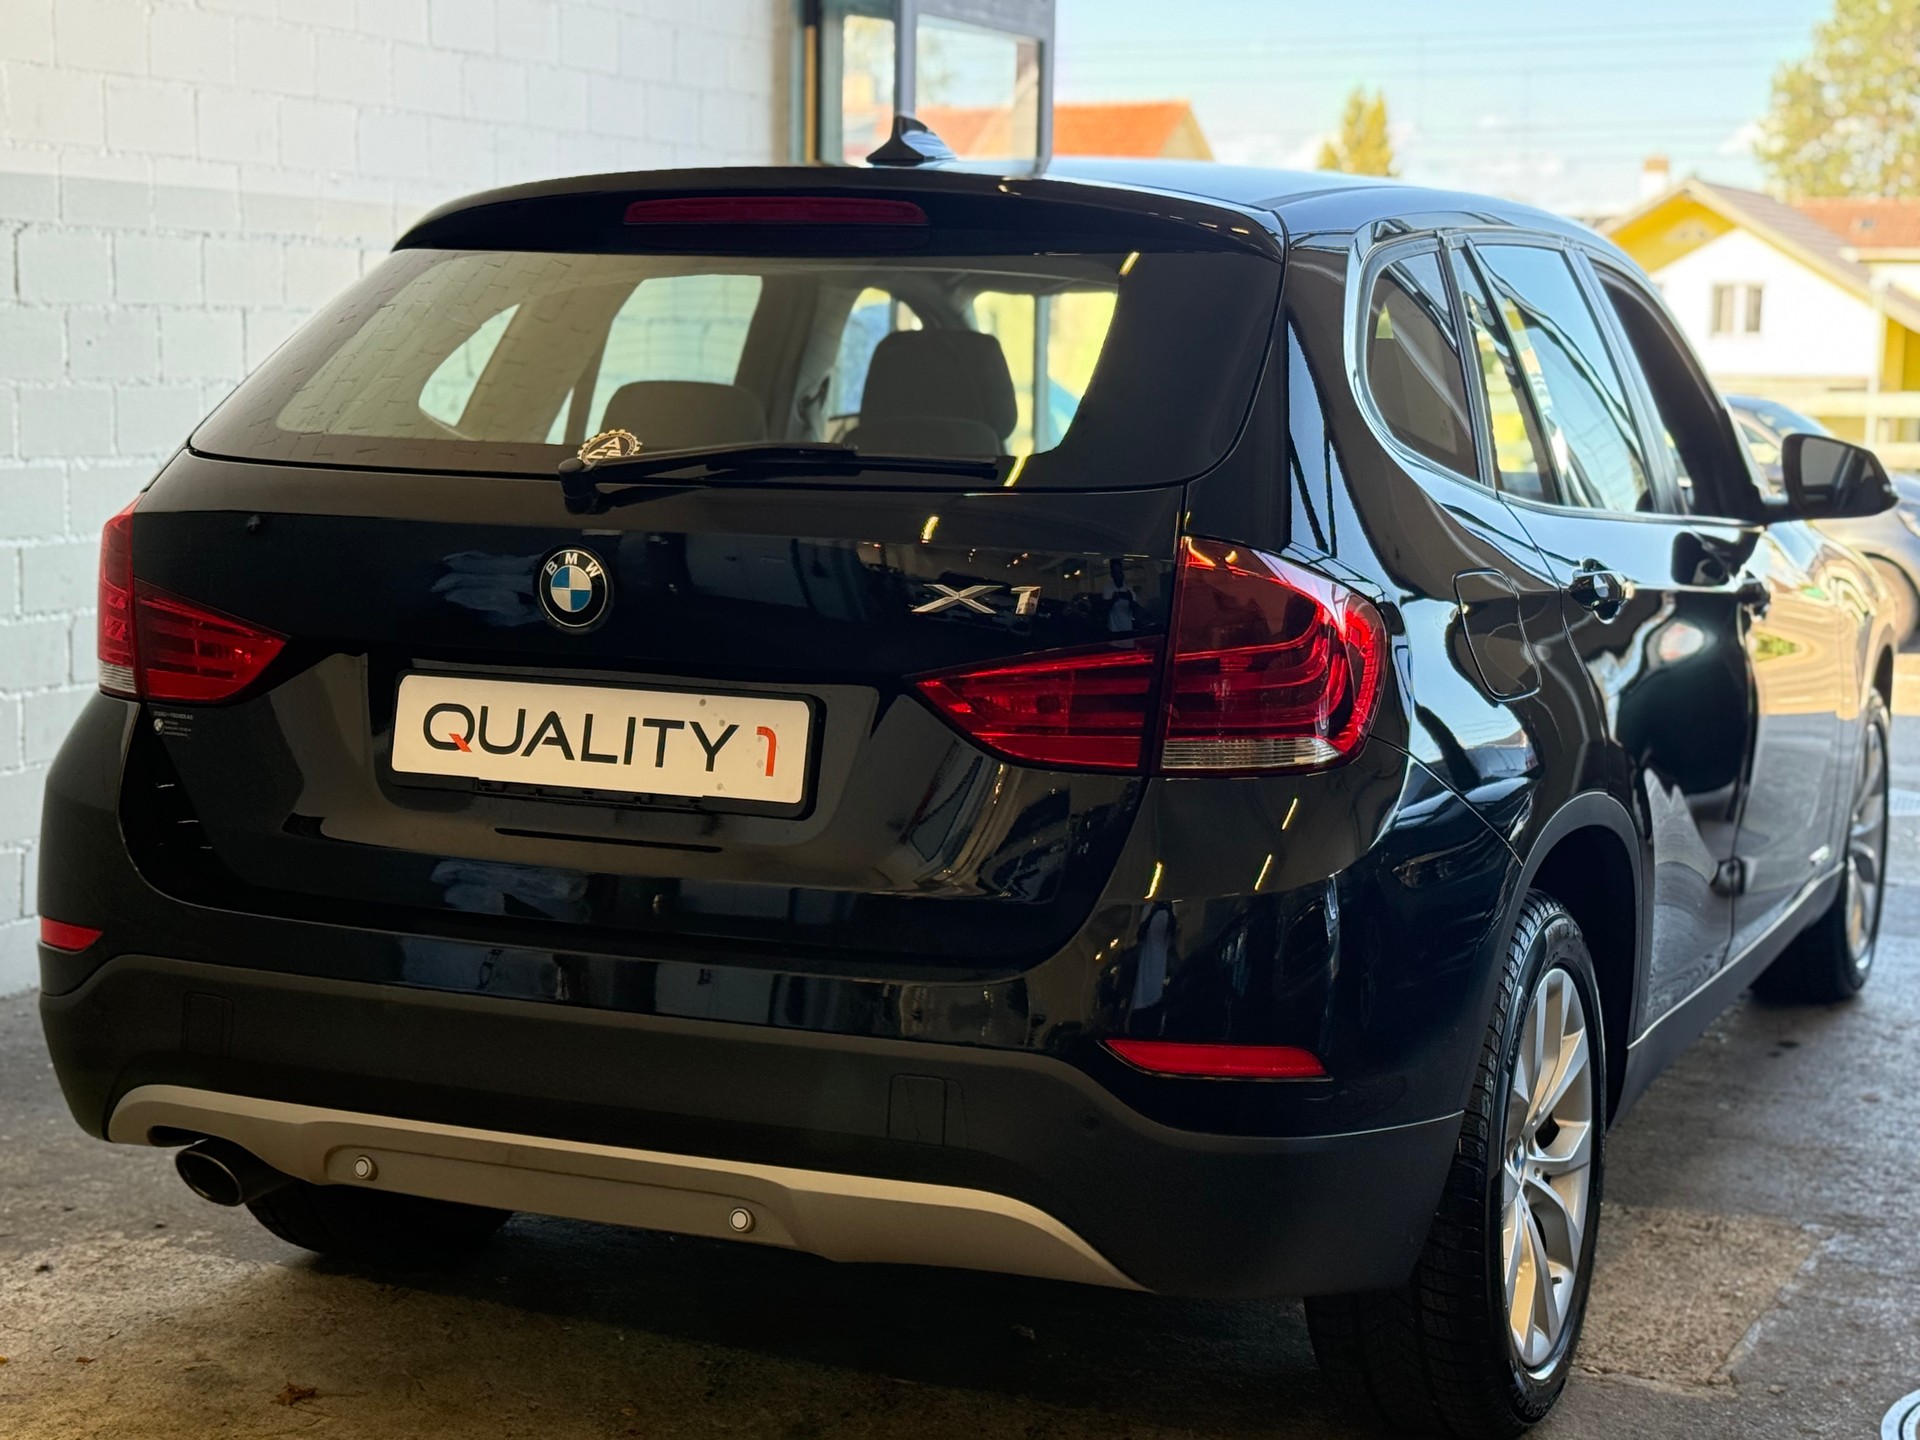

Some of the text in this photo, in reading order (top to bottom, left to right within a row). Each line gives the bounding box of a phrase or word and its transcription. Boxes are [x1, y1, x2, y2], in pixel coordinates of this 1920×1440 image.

[545, 552, 600, 578] BMW
[910, 583, 1042, 615] X1
[422, 702, 778, 778] QUALITY 1
